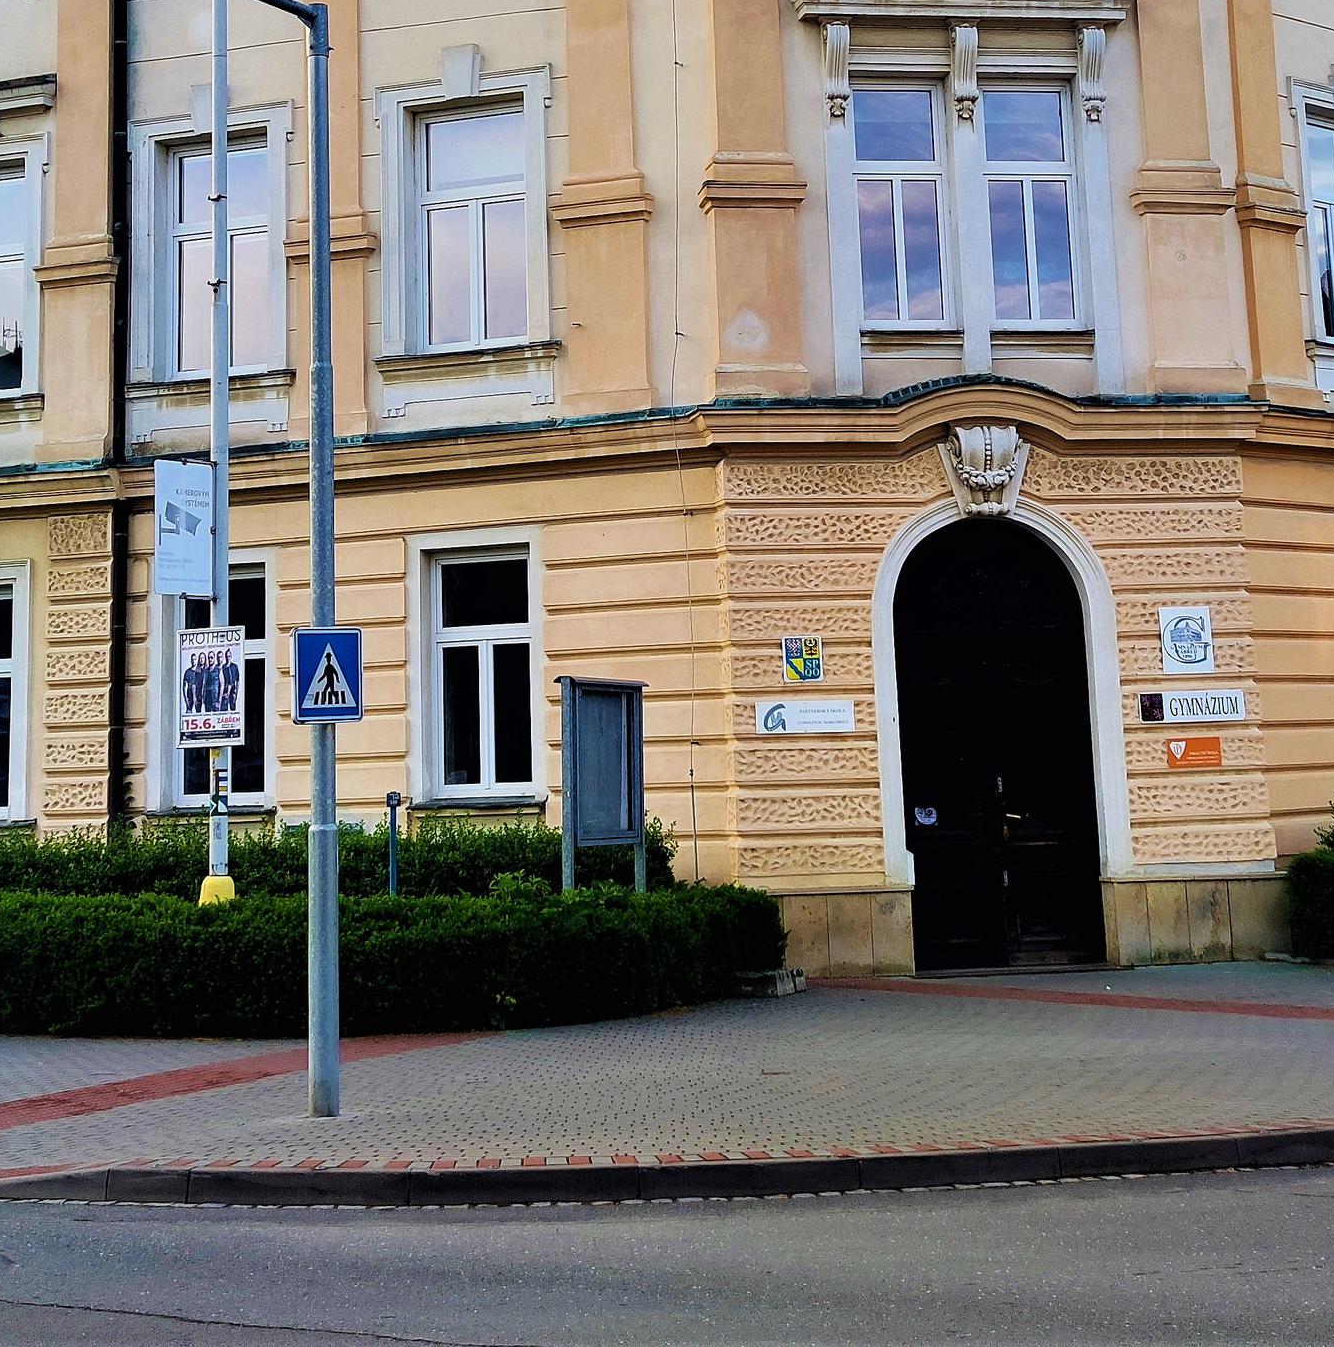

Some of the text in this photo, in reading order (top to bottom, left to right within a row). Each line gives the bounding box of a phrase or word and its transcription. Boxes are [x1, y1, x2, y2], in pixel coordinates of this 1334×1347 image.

[806, 659, 819, 668] SP
[1169, 692, 1239, 717] GYMNÁZIUM
[184, 718, 216, 730] 15.6.
